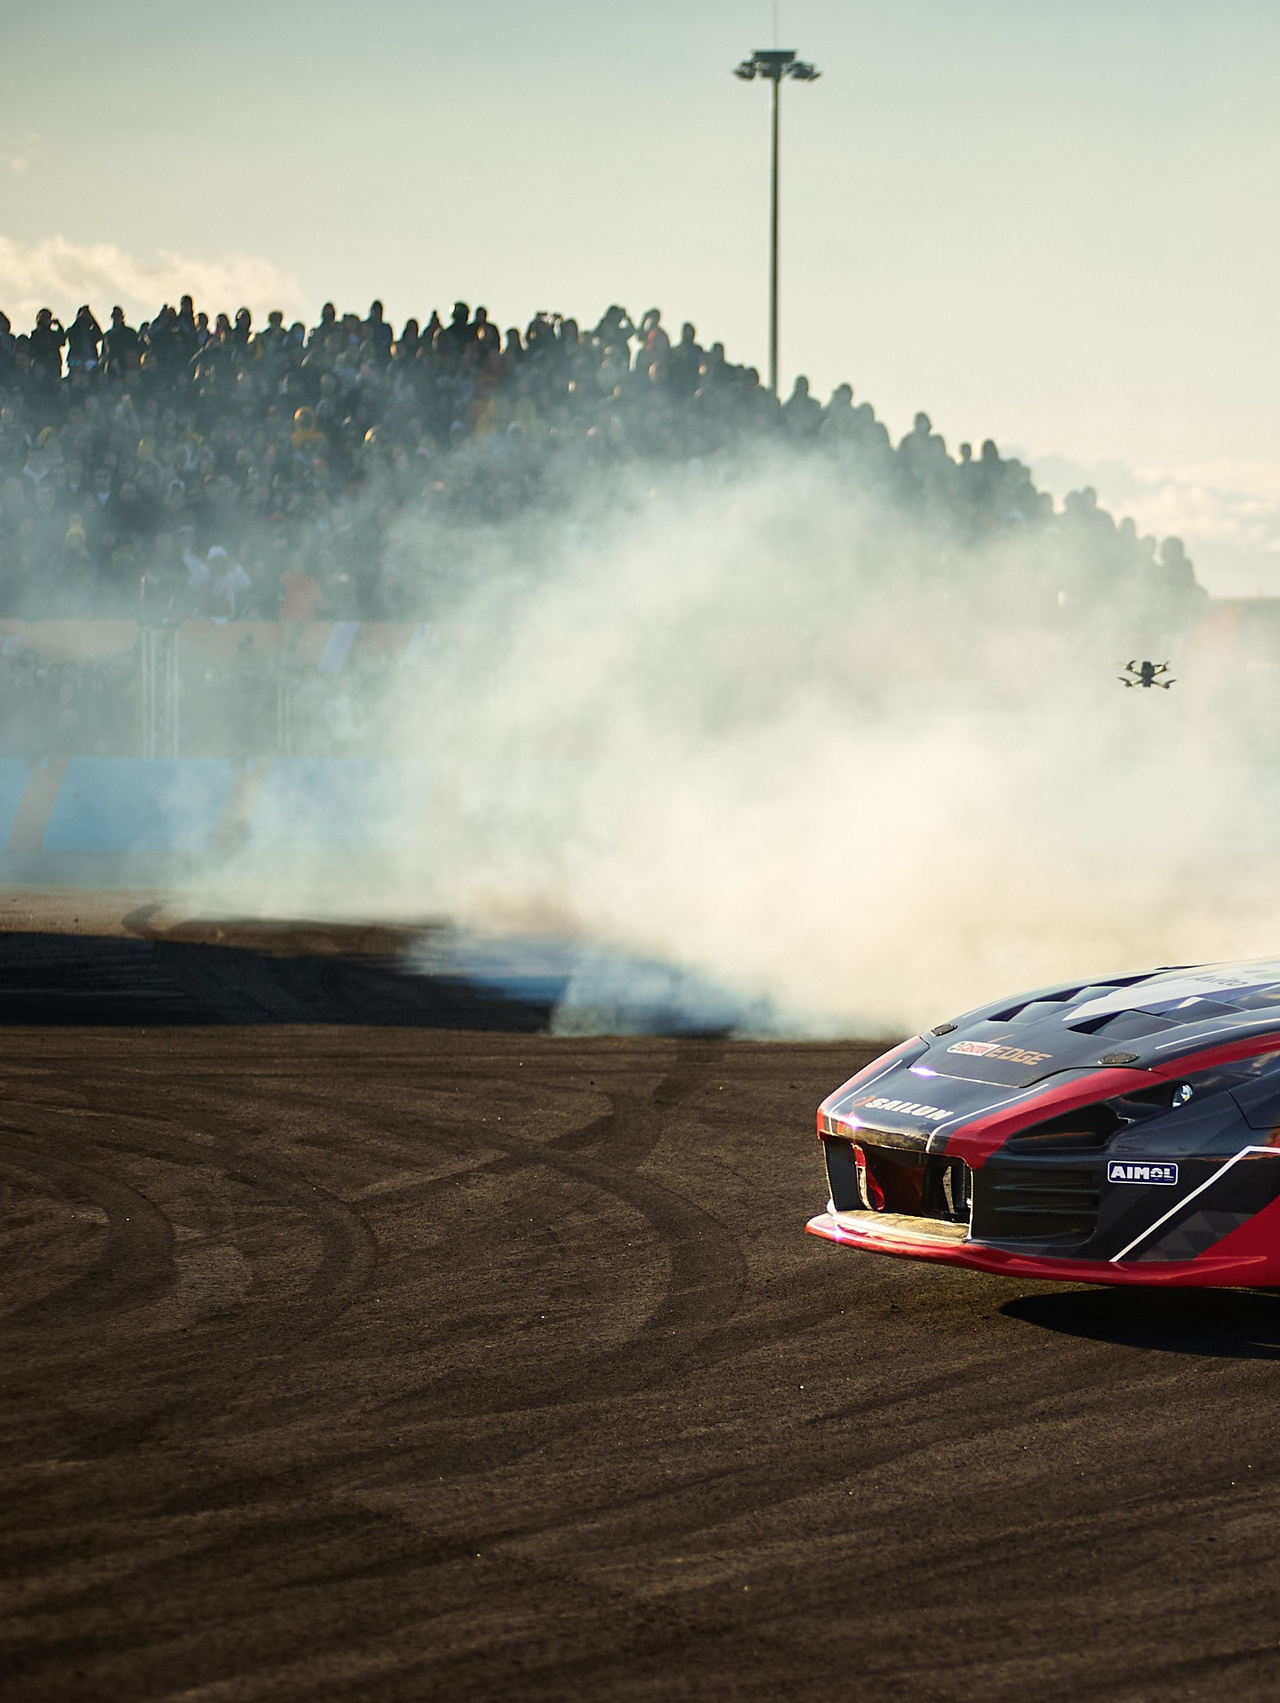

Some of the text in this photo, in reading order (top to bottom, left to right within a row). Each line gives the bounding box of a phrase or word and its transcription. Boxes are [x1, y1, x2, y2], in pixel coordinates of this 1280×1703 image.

[984, 1046, 1054, 1066] EDGE
[865, 1098, 954, 1120] SAILUN
[1110, 1165, 1174, 1180] AIMOL
